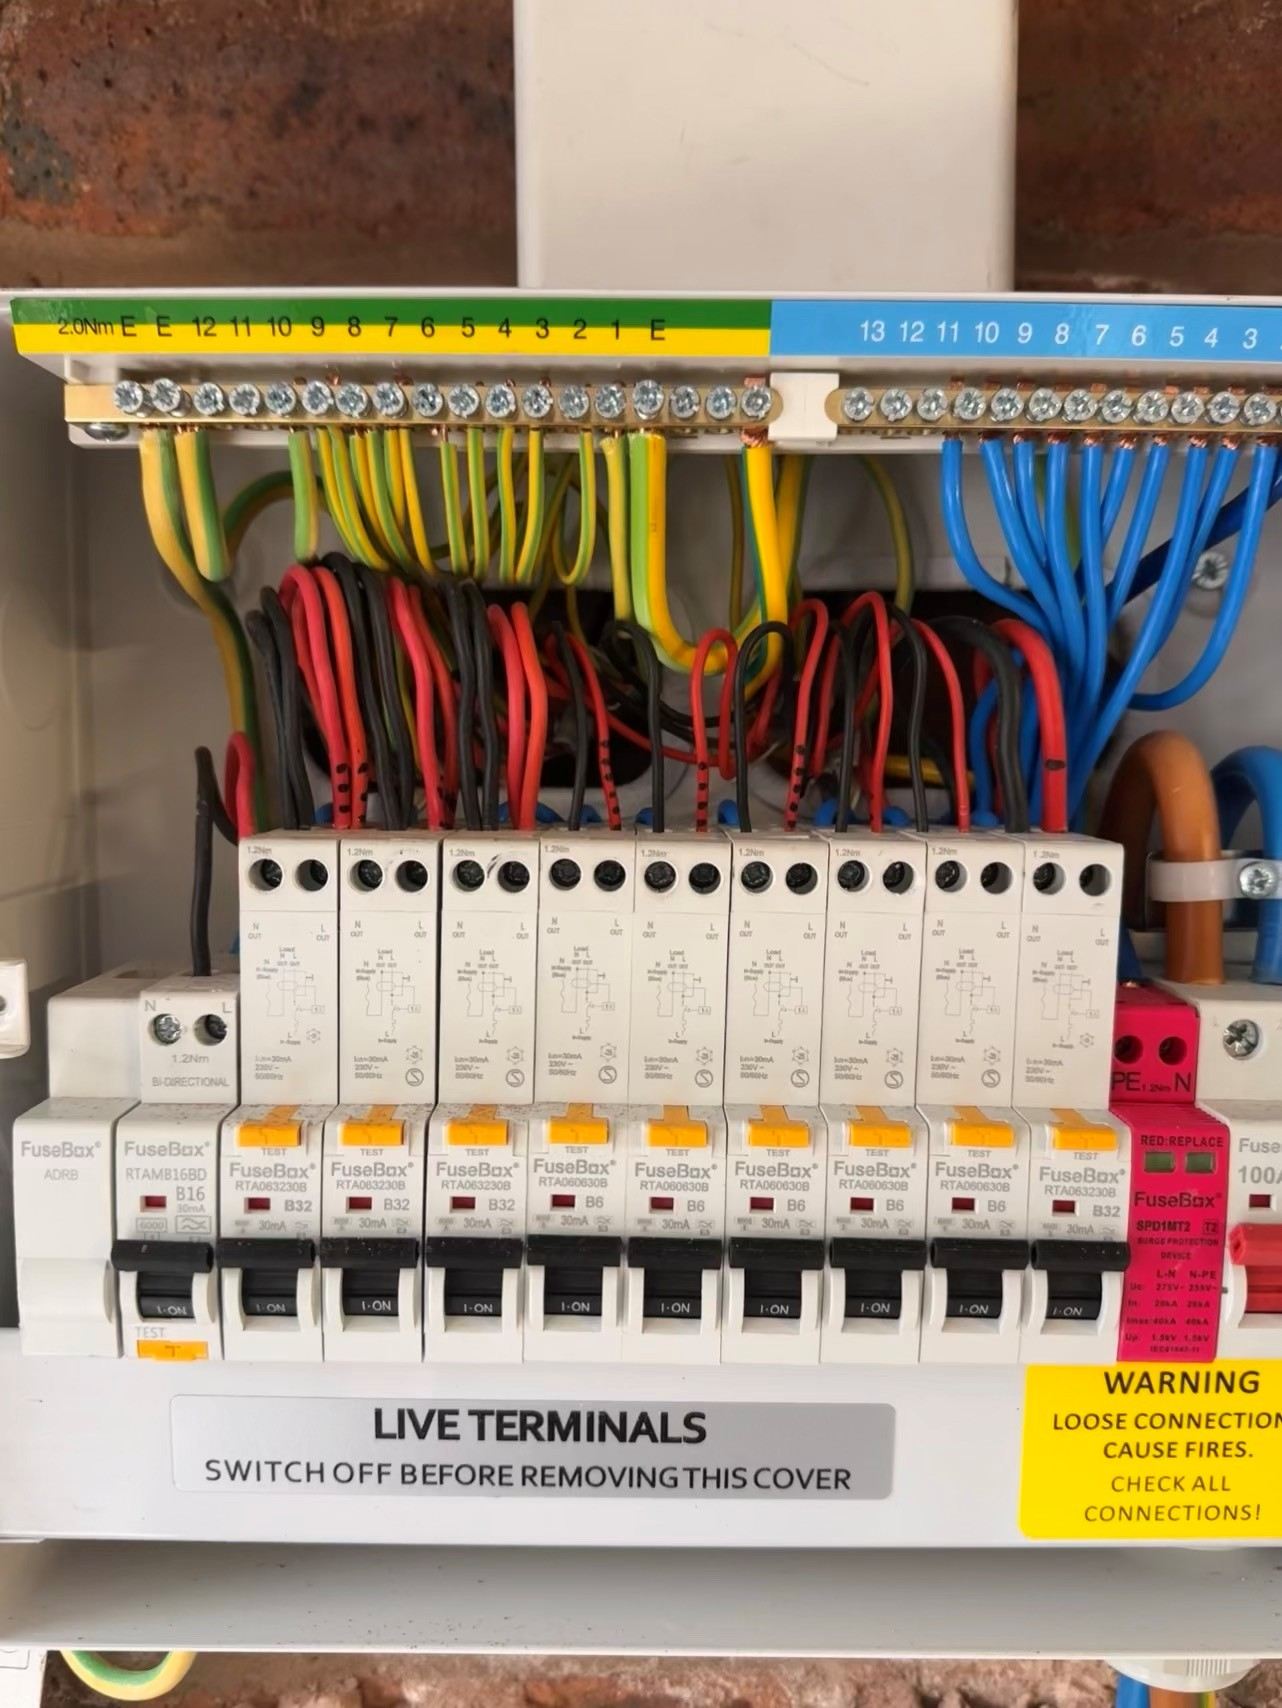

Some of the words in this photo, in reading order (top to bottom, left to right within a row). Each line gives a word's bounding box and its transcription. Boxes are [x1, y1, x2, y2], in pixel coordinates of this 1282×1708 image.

[58, 317, 113, 336] 2.0Nm
[121, 316, 137, 337] E
[157, 316, 172, 337] E
[192, 317, 217, 337] 12
[230, 317, 251, 337] 11
[269, 317, 292, 337] 10
[311, 317, 325, 337] 9
[347, 317, 362, 337] 8
[385, 317, 399, 337] 7
[421, 317, 435, 338] 6
[461, 318, 475, 338] 5
[498, 318, 512, 338] 4
[535, 318, 550, 339] 3
[573, 319, 587, 339] 2
[612, 319, 620, 340] 1
[650, 319, 665, 340] E
[860, 320, 885, 342] 13
[899, 321, 926, 343] 12
[937, 321, 960, 343] 11
[975, 321, 1000, 344] 10
[1018, 322, 1033, 344] 9
[1054, 322, 1070, 345] 8
[1095, 323, 1110, 345] 7
[1131, 324, 1147, 346] 6
[1169, 326, 1184, 347] 5
[1204, 328, 1218, 348] 4
[1242, 328, 1258, 349] 3
[144, 1000, 156, 1012] N
[222, 1002, 232, 1013] L
[172, 1054, 209, 1064] 1.2Nm
[152, 1077, 230, 1087] BI-DIRECTIONAL
[1111, 1072, 1141, 1091] PE
[1175, 1072, 1191, 1092] N
[262, 1148, 287, 1156] TEST
[465, 1149, 489, 1157] TEST
[565, 1146, 589, 1154] TEST
[666, 1149, 690, 1157] TEST
[766, 1149, 790, 1157] TEST
[866, 1149, 889, 1157] TEST
[968, 1150, 992, 1158] TEST
[1074, 1152, 1098, 1160] TEST
[44, 1169, 78, 1181] ADRB
[1238, 1166, 1282, 1184] 100
[176, 1186, 205, 1201] B16
[285, 1200, 312, 1212] B32
[384, 1199, 410, 1211] B32
[489, 1199, 515, 1211] B32
[585, 1196, 604, 1208] B6
[687, 1200, 705, 1212] B6
[787, 1200, 806, 1212] B6
[886, 1200, 904, 1212] B6
[988, 1200, 1006, 1212] B6
[1093, 1205, 1120, 1217] B32
[259, 1220, 286, 1231] 30mA
[359, 1217, 387, 1229] 30mA
[464, 1218, 492, 1229] 30mA
[561, 1216, 589, 1226] 30mA
[662, 1220, 690, 1230] 30mA
[762, 1219, 790, 1230] 30mA
[861, 1218, 889, 1229] 30mA
[962, 1219, 990, 1230] 30mA
[1067, 1224, 1095, 1235] 30mA
[135, 1326, 164, 1338] TEST
[1104, 1371, 1260, 1394] WARNING
[374, 1408, 461, 1441] LIVE
[468, 1409, 707, 1444] TERMINALS
[1053, 1413, 1127, 1430] LOOSE
[1103, 1442, 1178, 1458] CAUSE
[1185, 1441, 1253, 1458] FIRES.
[205, 1459, 324, 1484] SWITCH
[333, 1462, 391, 1484] OFF
[401, 1464, 514, 1487] BEFORE
[521, 1466, 678, 1489] REMOVING
[683, 1467, 747, 1489] THIS
[754, 1467, 851, 1490] COVER
[1111, 1476, 1185, 1492] CHECK
[1192, 1475, 1230, 1491] ALL
[1084, 1504, 1261, 1522] CONNECTIONS!
